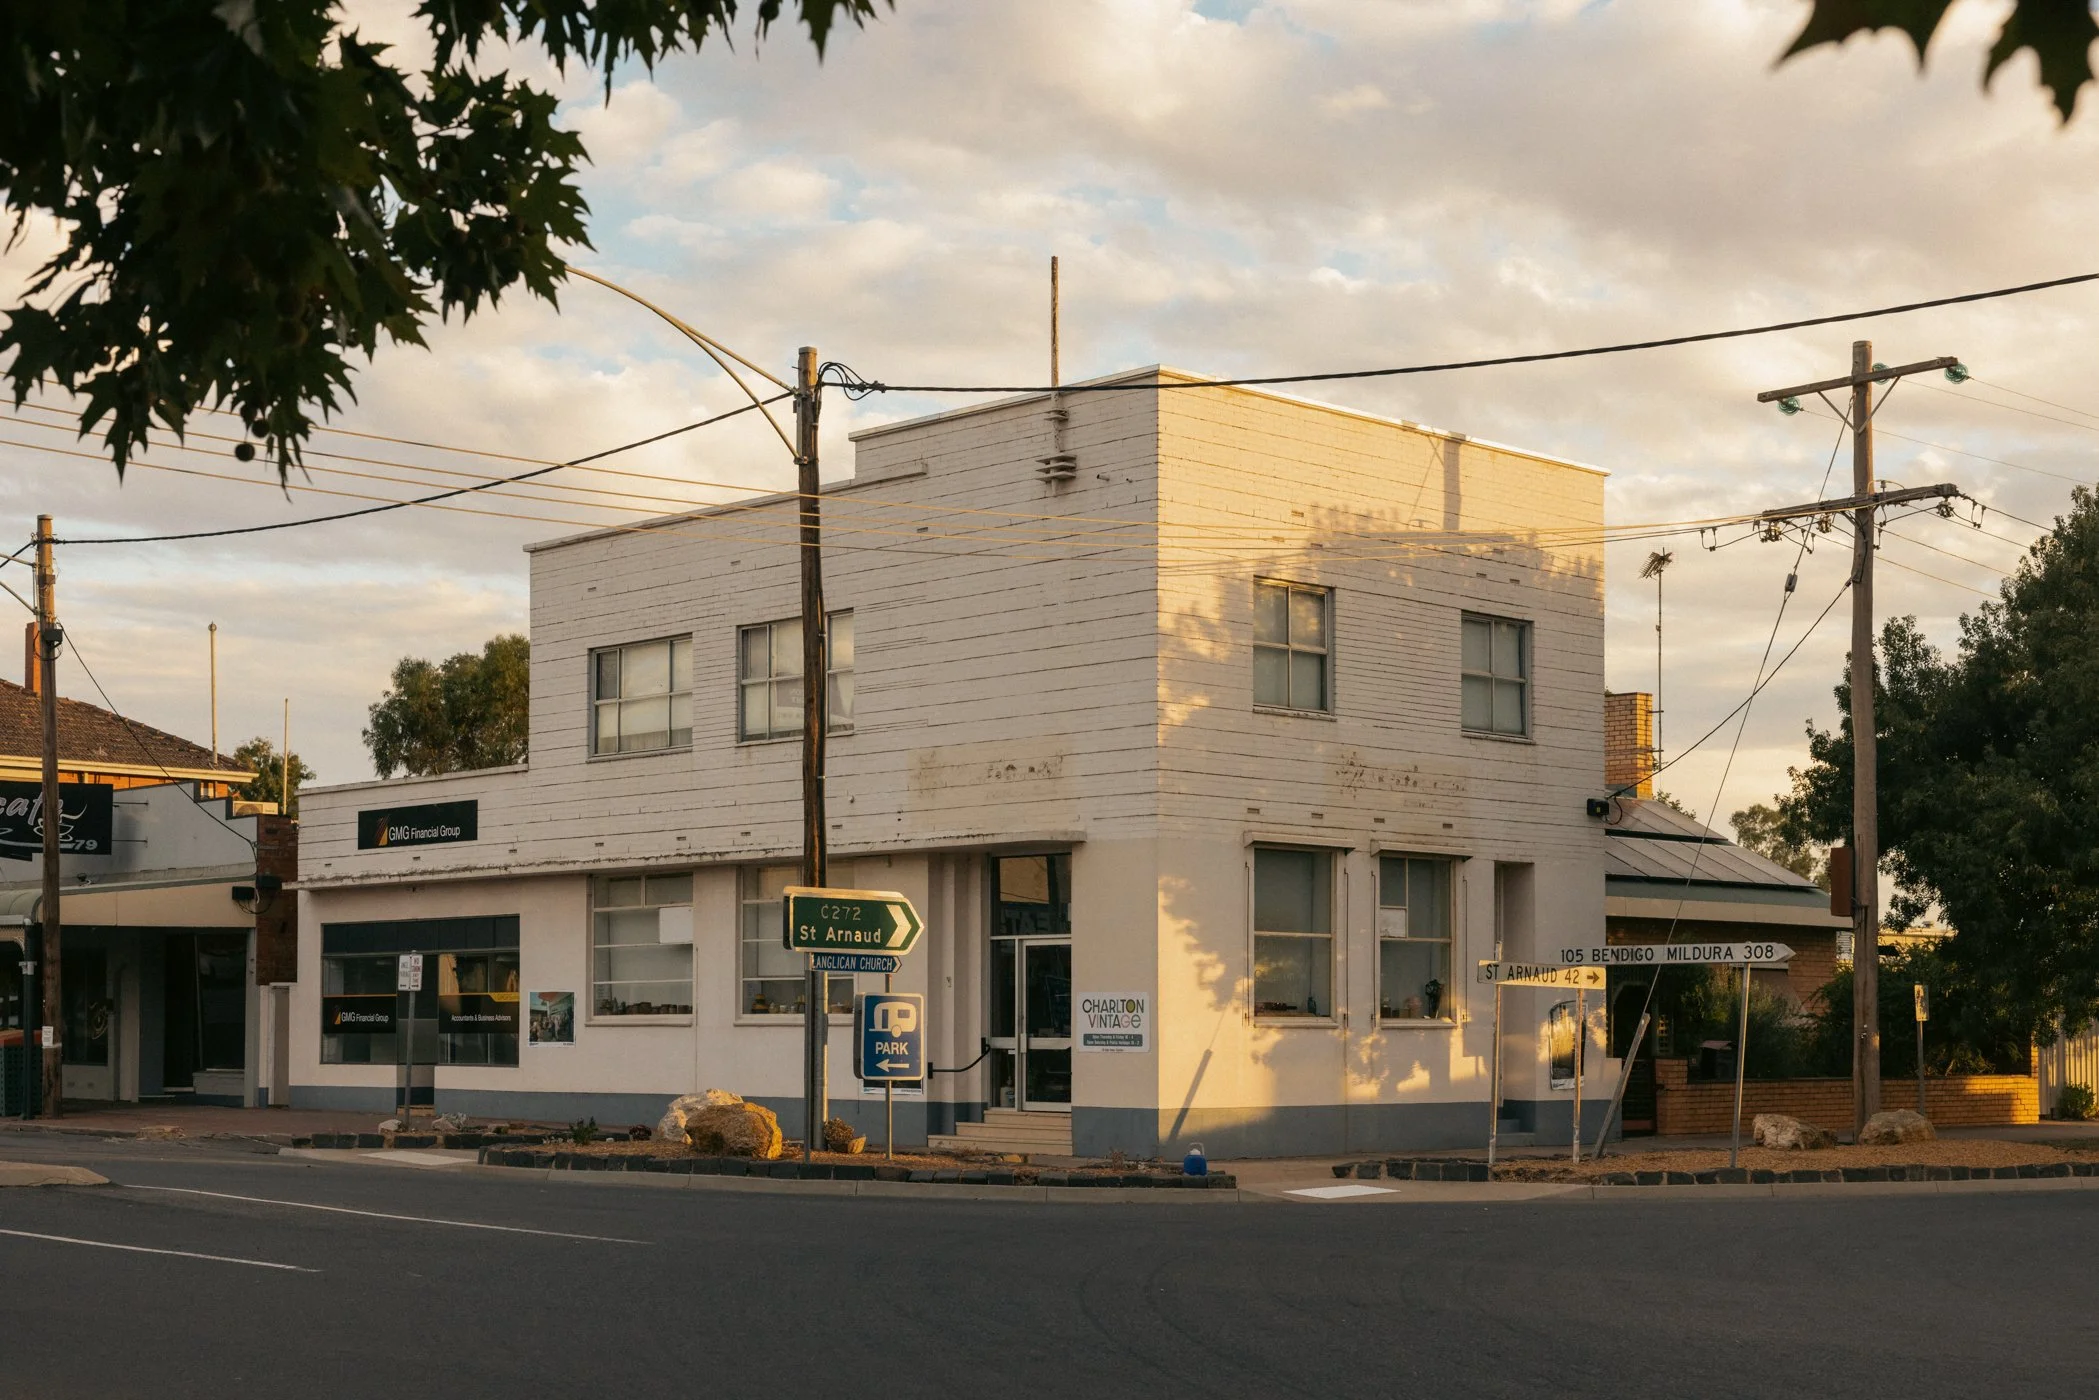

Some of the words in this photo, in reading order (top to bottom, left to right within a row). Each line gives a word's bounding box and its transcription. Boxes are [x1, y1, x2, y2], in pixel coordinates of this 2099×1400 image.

[389, 826, 410, 841] GMG
[411, 827, 438, 839] Financial
[440, 825, 460, 838] Group
[74, 840, 98, 850] 79
[821, 905, 861, 920] C272
[800, 925, 816, 941] St
[826, 927, 881, 943] Arnaud
[1561, 949, 1584, 963] 105
[1592, 947, 1654, 962] BENDIGO
[1667, 946, 1734, 960] MILDURA
[1743, 945, 1774, 959] 308
[815, 956, 857, 970] ANGLICAN
[860, 957, 893, 971] CHURCH
[1486, 964, 1499, 980] ST
[1507, 965, 1557, 983] ARNAUD
[1565, 969, 1580, 984] 42
[1082, 999, 1144, 1013] CHARLTON
[341, 1012, 355, 1022] GMG
[356, 1013, 375, 1022] Financial
[375, 1013, 389, 1023] Group
[875, 1041, 909, 1055] PARK
